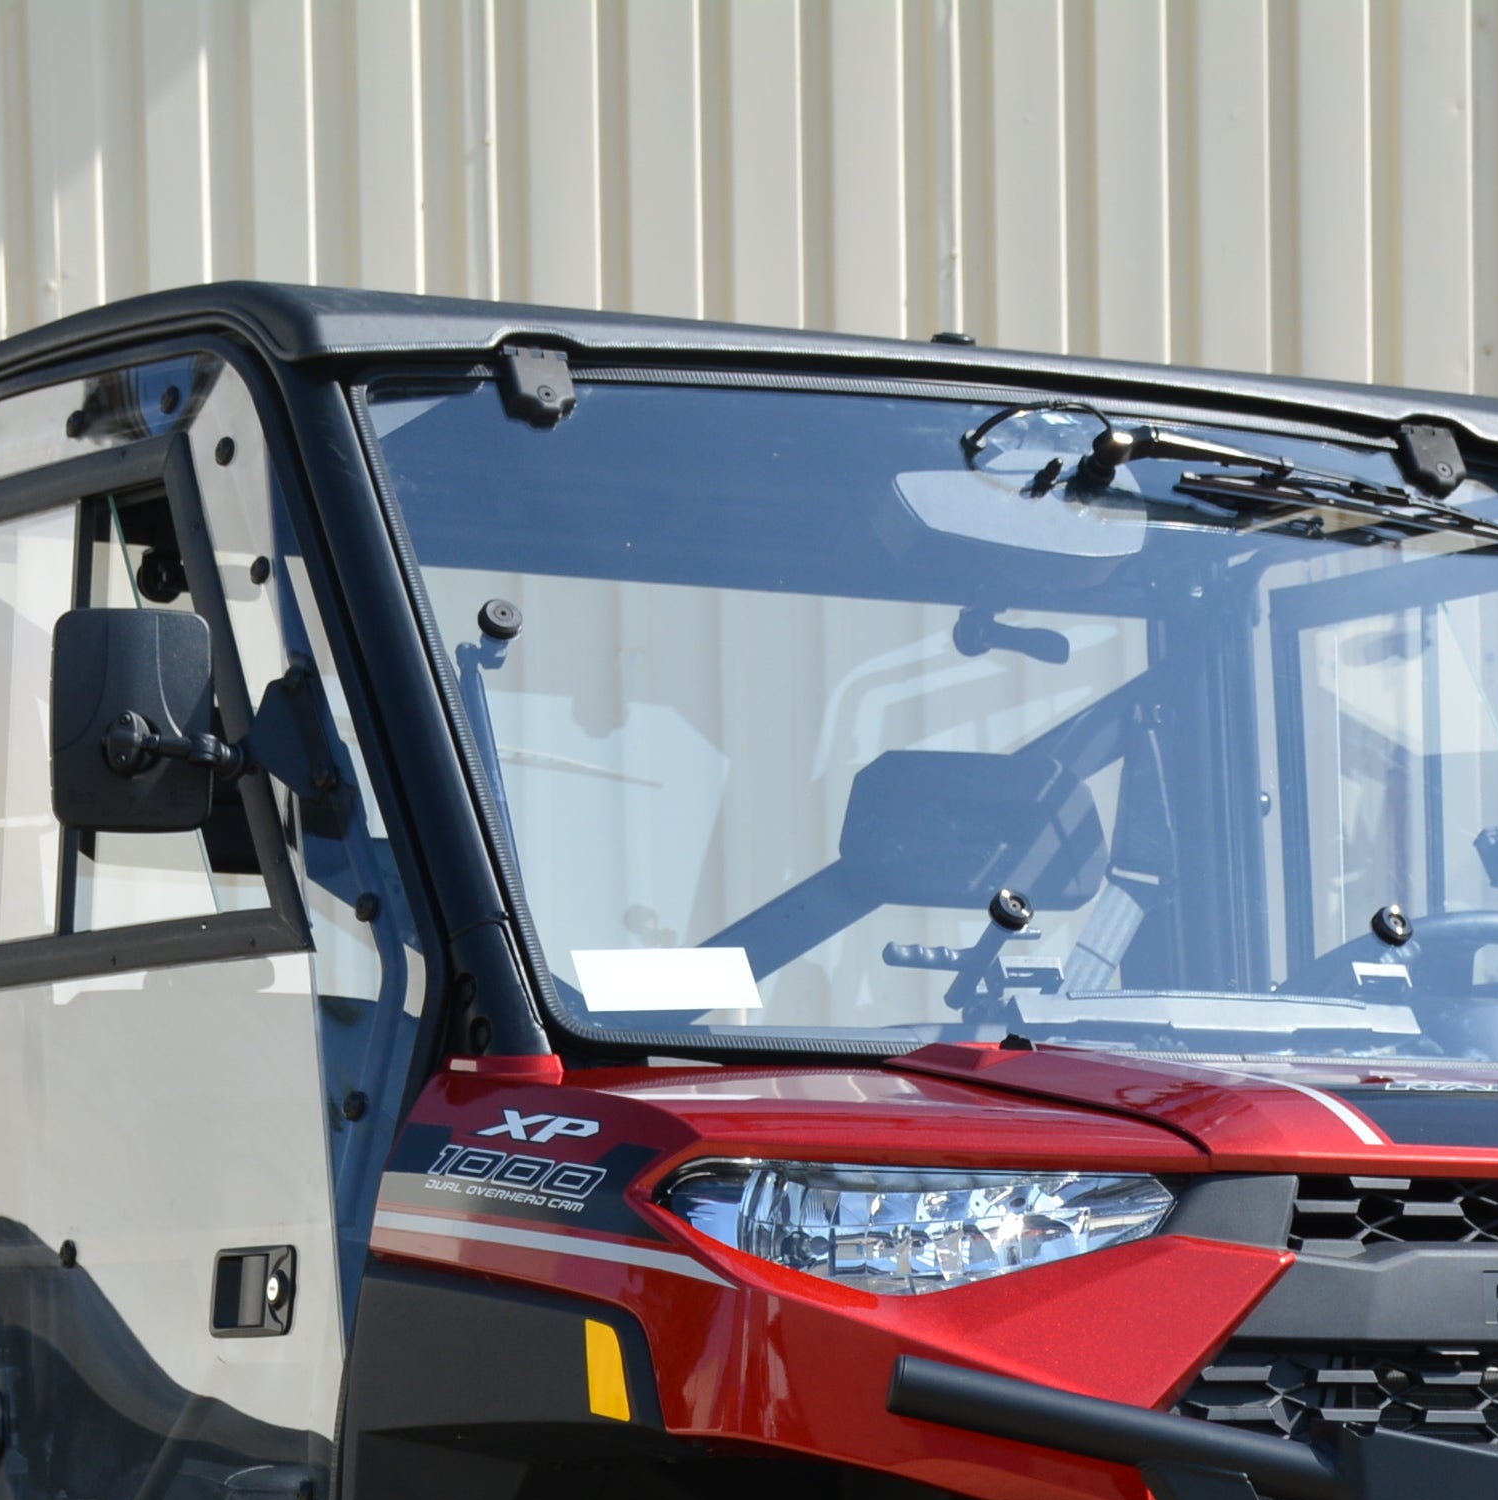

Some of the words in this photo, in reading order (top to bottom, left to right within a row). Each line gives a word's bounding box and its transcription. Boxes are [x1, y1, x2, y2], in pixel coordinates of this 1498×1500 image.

[476, 1109, 600, 1143] XP
[428, 1144, 607, 1199] 1000
[425, 1179, 462, 1194] DUAL
[465, 1185, 547, 1206] OVERHEAD
[547, 1198, 585, 1213] CAM
